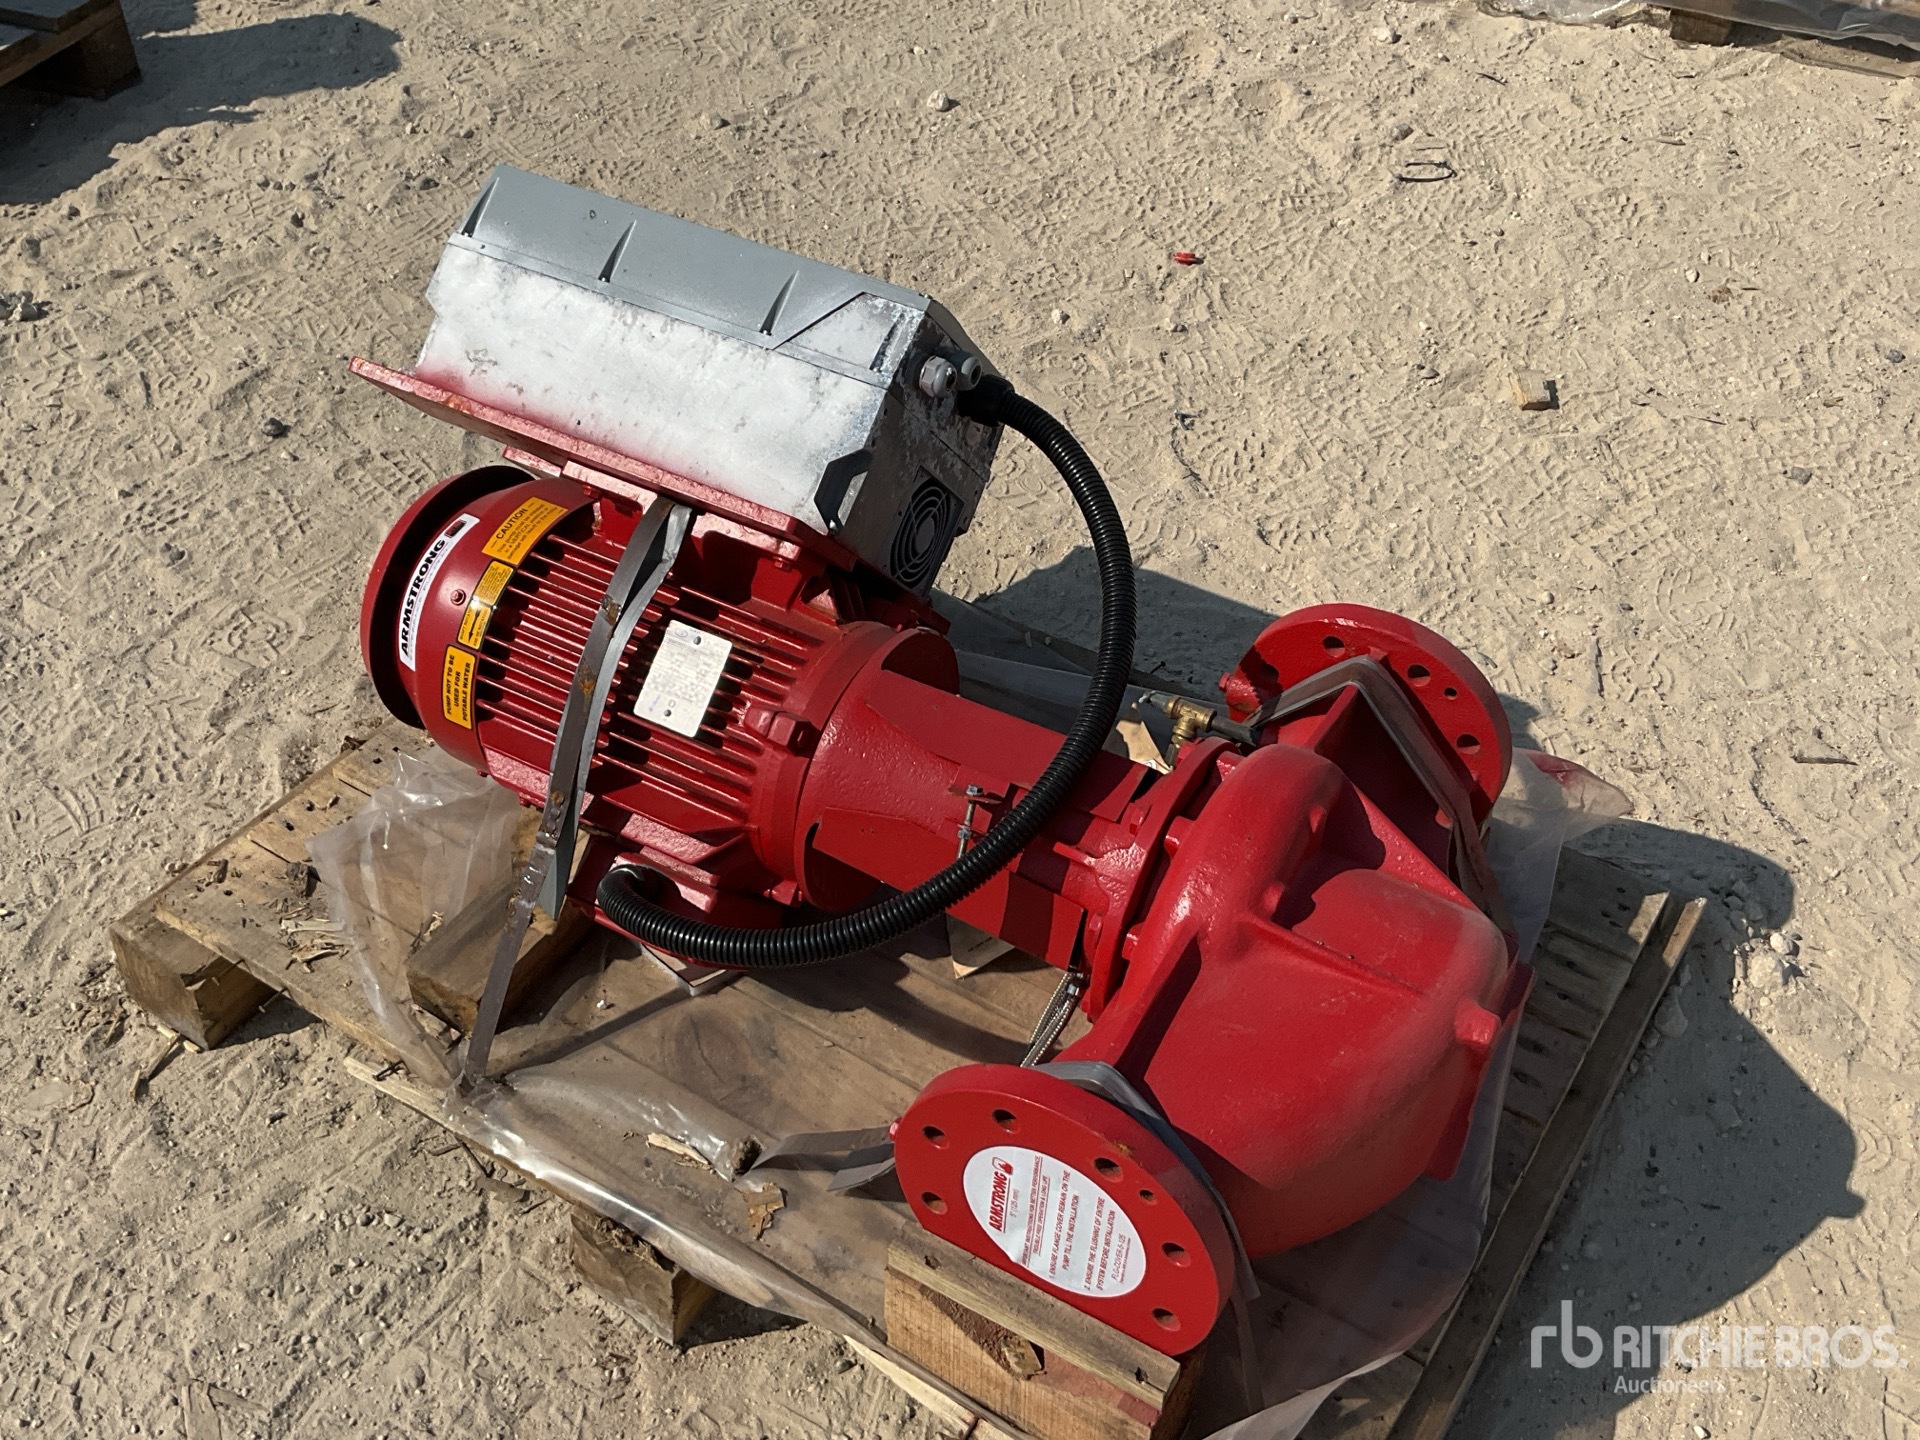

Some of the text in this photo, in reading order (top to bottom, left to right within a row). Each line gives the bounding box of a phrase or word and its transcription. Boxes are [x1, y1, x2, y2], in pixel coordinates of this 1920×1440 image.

[496, 508, 528, 539] CAUTION
[510, 524, 530, 543] VERTICAL
[401, 540, 445, 656] ARMSTRONG
[449, 655, 455, 665] BE
[447, 666, 453, 677] TO
[989, 1171, 1006, 1230] ARMSTRONG
[1058, 1191, 1066, 1212] REMAIN
[1096, 1197, 1104, 1217] ENTIRE
[1068, 1194, 1079, 1231] INSTALLATION
[1094, 1217, 1101, 1225] OF
[1090, 1226, 1100, 1251] FLUSHING
[1096, 1210, 1115, 1289] SYSTEM BEFORE INSTALLATION
[1085, 1263, 1094, 1283] ENSURE
